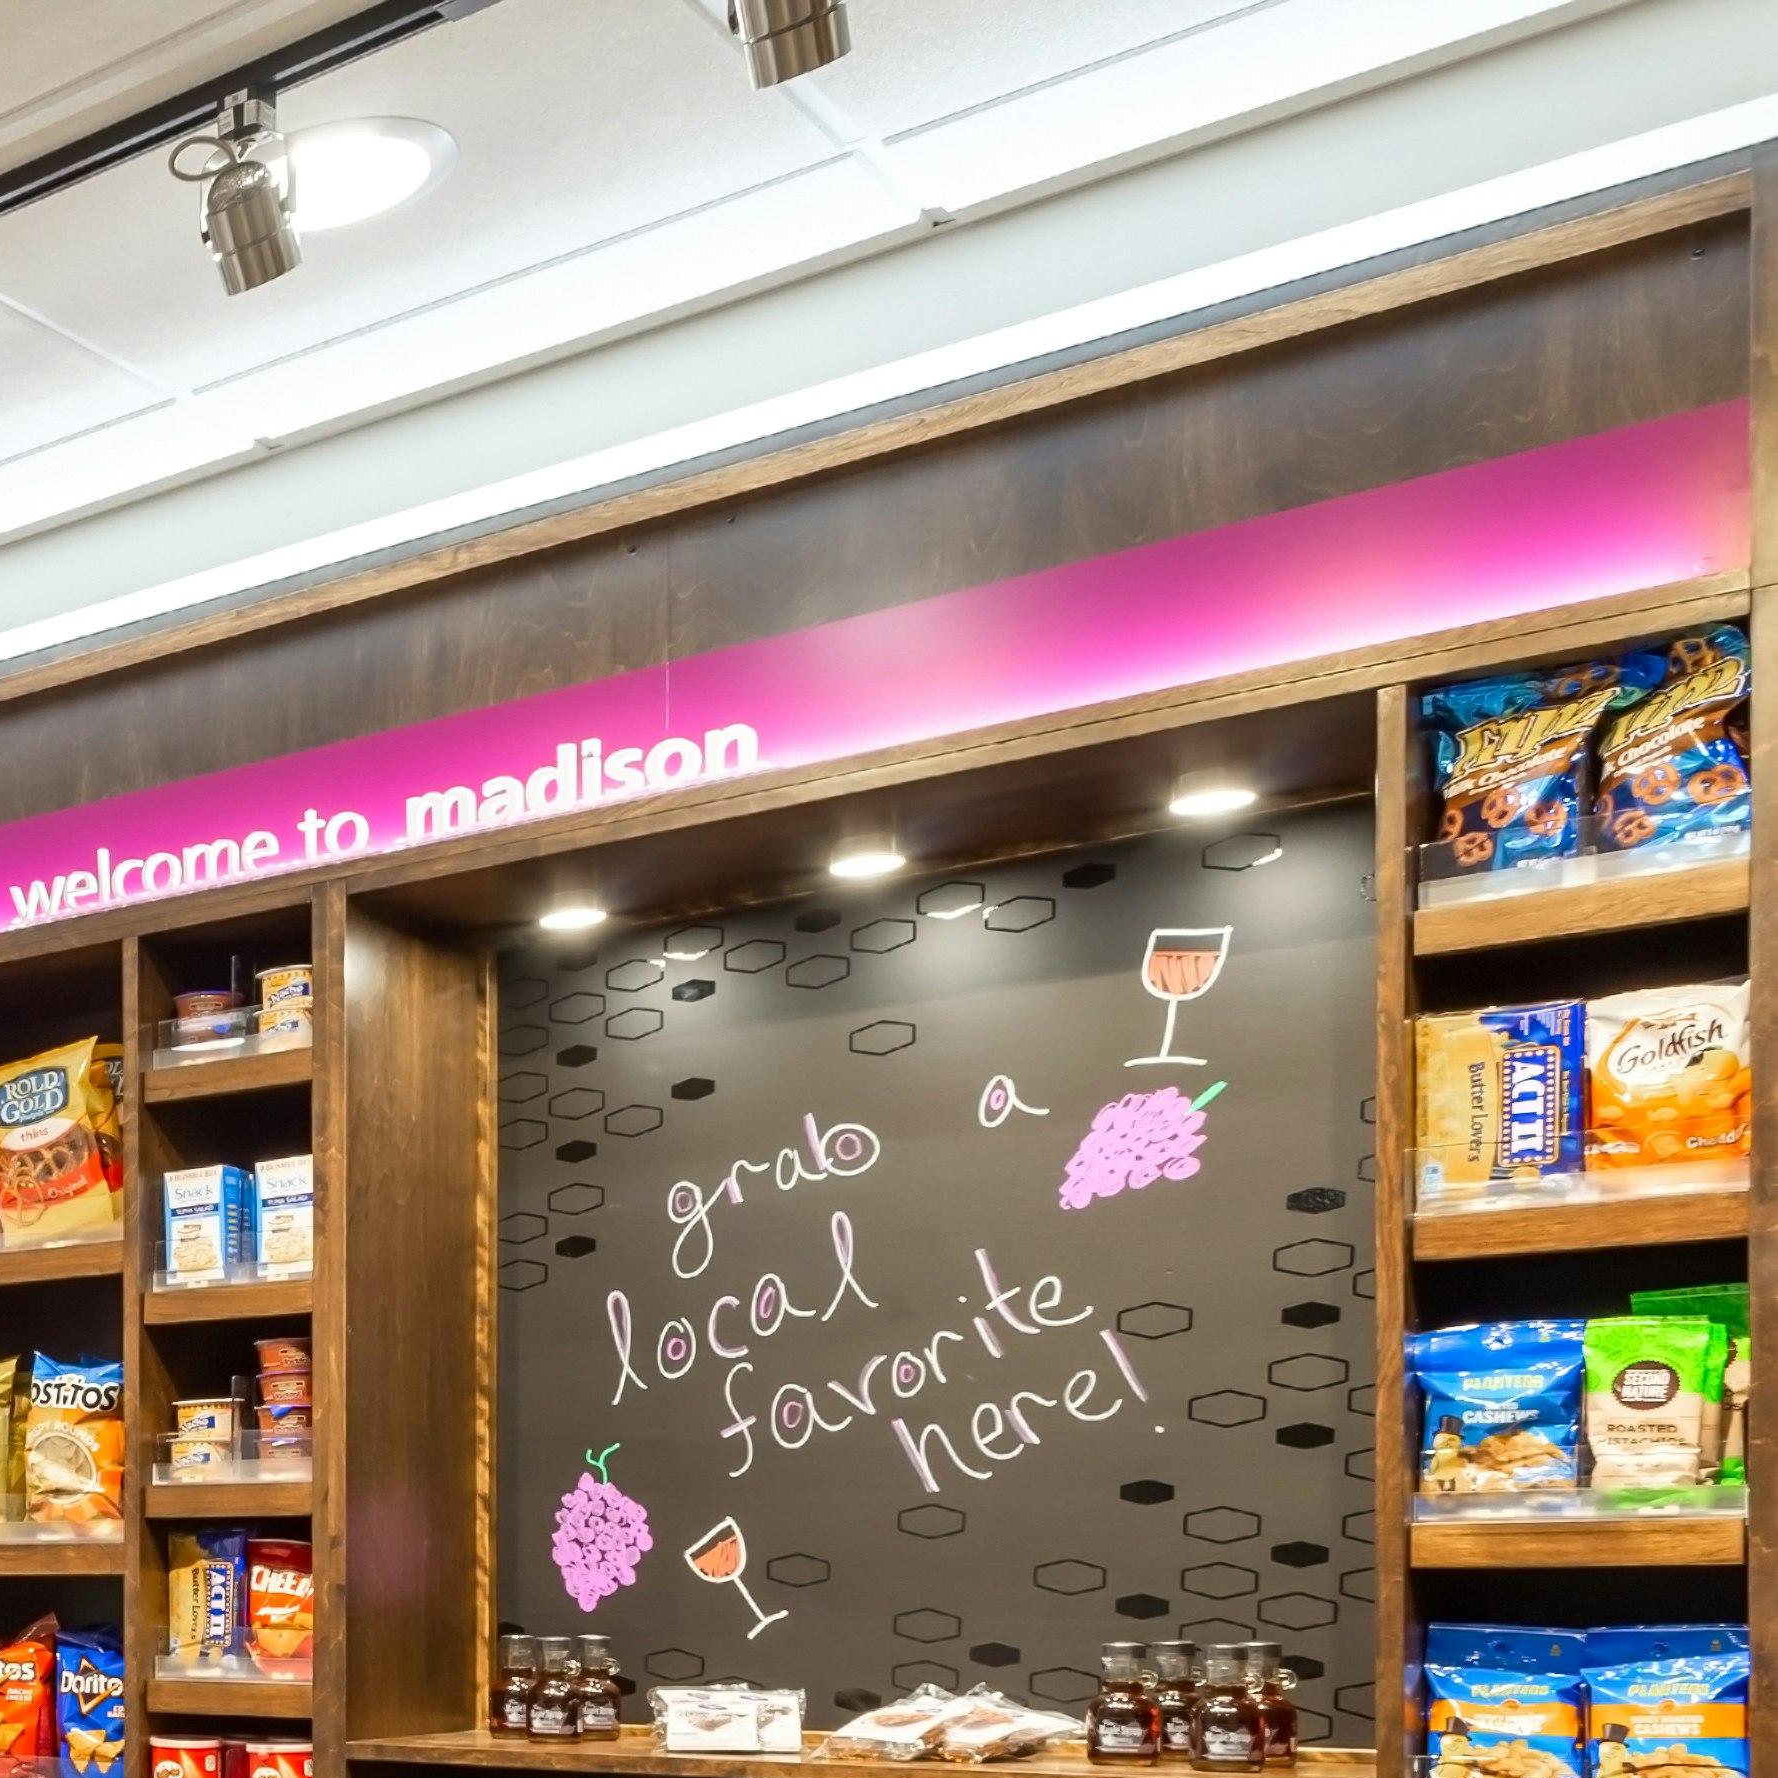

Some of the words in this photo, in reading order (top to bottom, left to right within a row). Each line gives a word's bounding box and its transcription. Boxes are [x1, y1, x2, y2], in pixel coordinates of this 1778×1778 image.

[1618, 717, 1705, 765] Chocolate
[1479, 747, 1567, 784] Chocolate
[9, 829, 279, 926] welcome
[298, 808, 369, 861] to
[404, 722, 760, 848] madison
[1616, 1017, 1728, 1075] Goldfish
[5, 1070, 59, 1100] ROLD
[1468, 1061, 1486, 1111] Butter
[1511, 1061, 1545, 1115] ACT
[0, 1090, 64, 1124] GOLD
[20, 1126, 49, 1143] thins
[1468, 1112, 1488, 1162] Lovers
[1511, 1120, 1545, 1155] II
[47, 1175, 89, 1199] Original
[174, 1184, 213, 1200] Snack
[267, 1175, 308, 1190] Snack
[666, 1112, 880, 1279] grab
[977, 1074, 1050, 1128] a
[606, 1211, 878, 1406] local
[720, 1247, 1094, 1478] favorite
[1622, 1371, 1671, 1386] SECOND
[1622, 1385, 1669, 1400] NATURE
[891, 1328, 1166, 1493] here!
[1462, 1408, 1541, 1424] CASHEWS
[54, 1421, 101, 1452] ROUNDS
[1606, 1423, 1678, 1434] ROASTED
[210, 1571, 225, 1610] ACT
[1628, 1682, 1710, 1697] PLANTERS
[1634, 1723, 1701, 1736] CASHEWS
